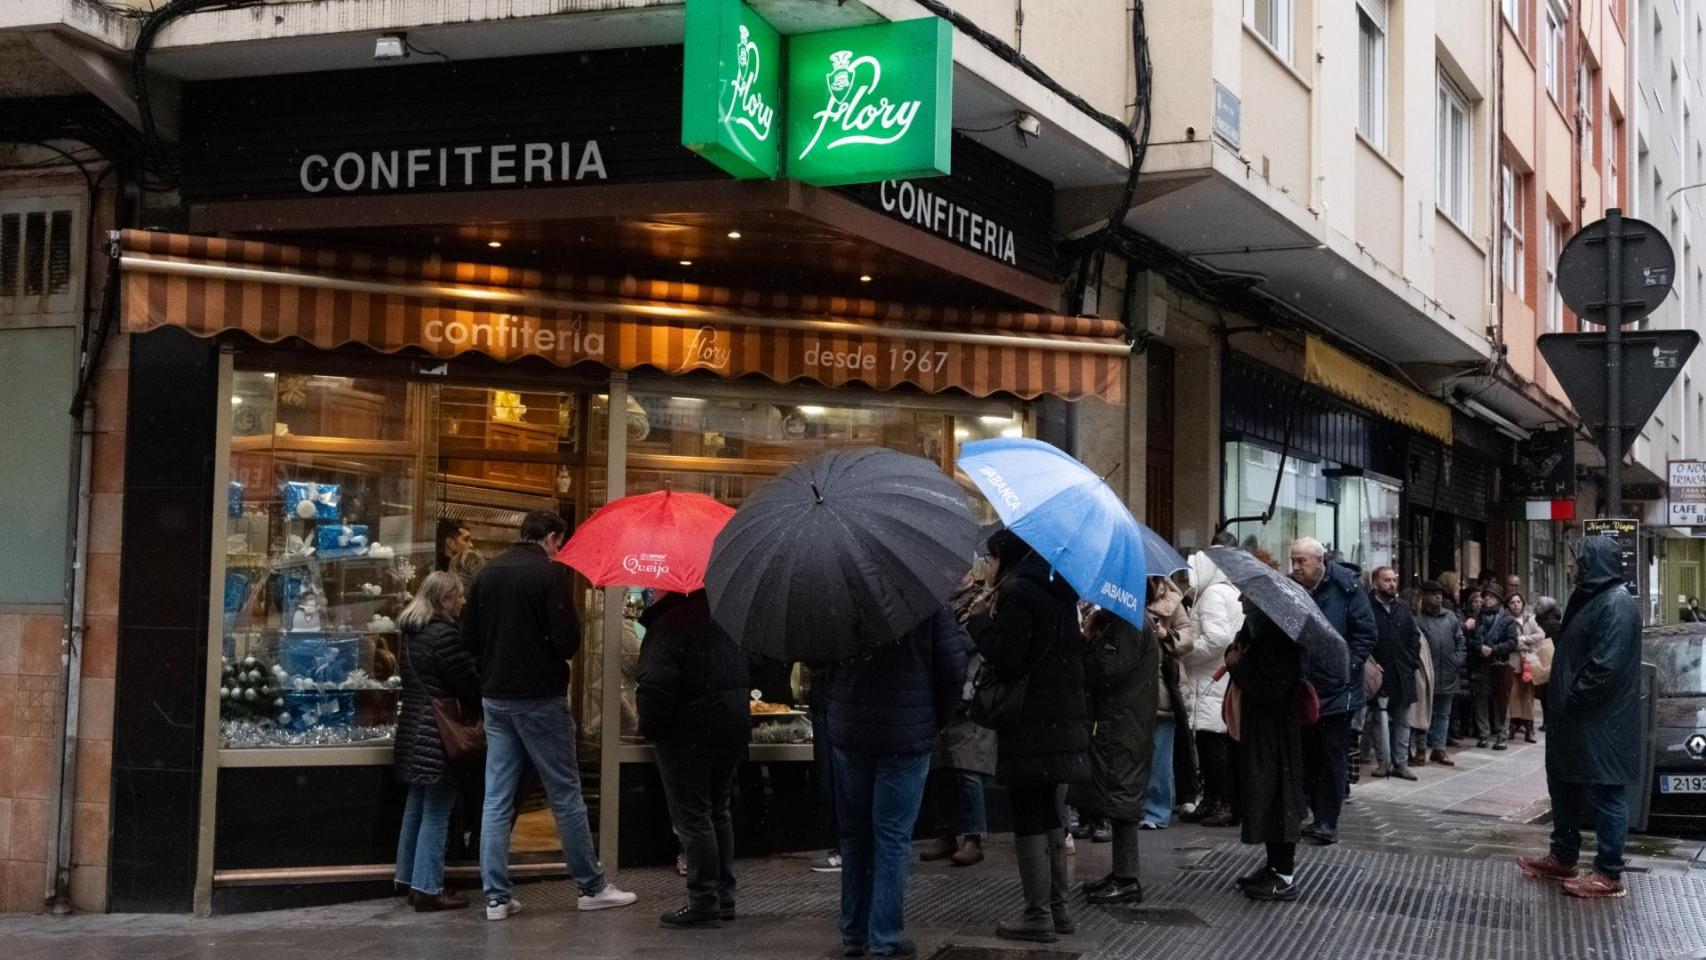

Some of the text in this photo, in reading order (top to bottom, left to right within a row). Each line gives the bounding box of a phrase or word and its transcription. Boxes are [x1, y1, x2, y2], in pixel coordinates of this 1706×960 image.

[799, 55, 921, 160] Flory
[300, 140, 607, 193] CONFITERIA
[880, 180, 1016, 265] CONFITERIA
[804, 342, 949, 374] desde 1967
[983, 467, 1022, 511] ABANCA
[1673, 504, 1698, 514] CAFE
[623, 555, 669, 578] Queijo
[1103, 582, 1137, 612] ABANCA
